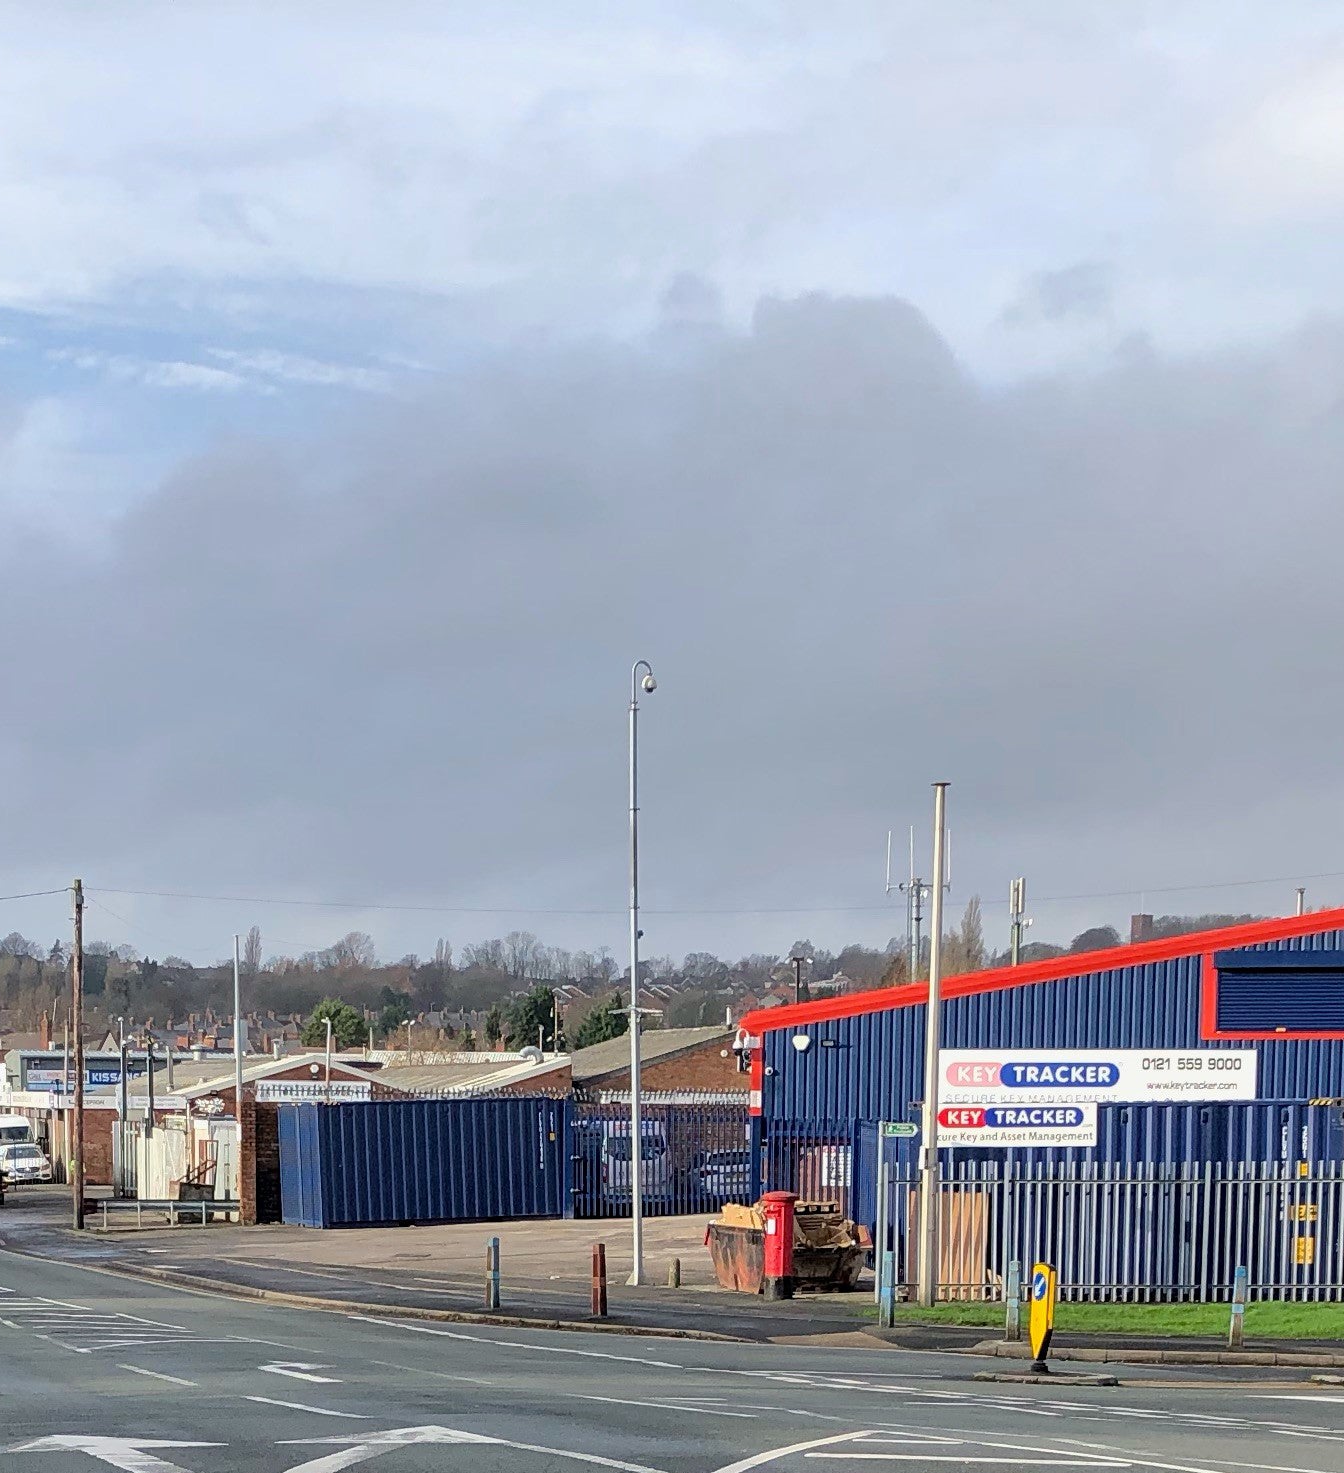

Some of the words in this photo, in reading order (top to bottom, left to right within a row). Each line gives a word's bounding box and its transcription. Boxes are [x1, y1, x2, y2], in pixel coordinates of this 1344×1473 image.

[1142, 1057, 1171, 1071] 0121
[1177, 1057, 1203, 1071] 559
[1207, 1057, 1242, 1071] 9000
[956, 1065, 998, 1083] KEY
[1012, 1065, 1112, 1083] TRACKER
[1146, 1080, 1238, 1092] www.keytracker.com
[947, 1110, 982, 1125] KEY
[994, 1110, 1077, 1125] TRACKER
[937, 1132, 958, 1142] cure
[959, 1131, 977, 1143] Key
[979, 1131, 998, 1141] and
[1000, 1131, 1026, 1141] Asset
[1028, 1131, 1094, 1143] Management
